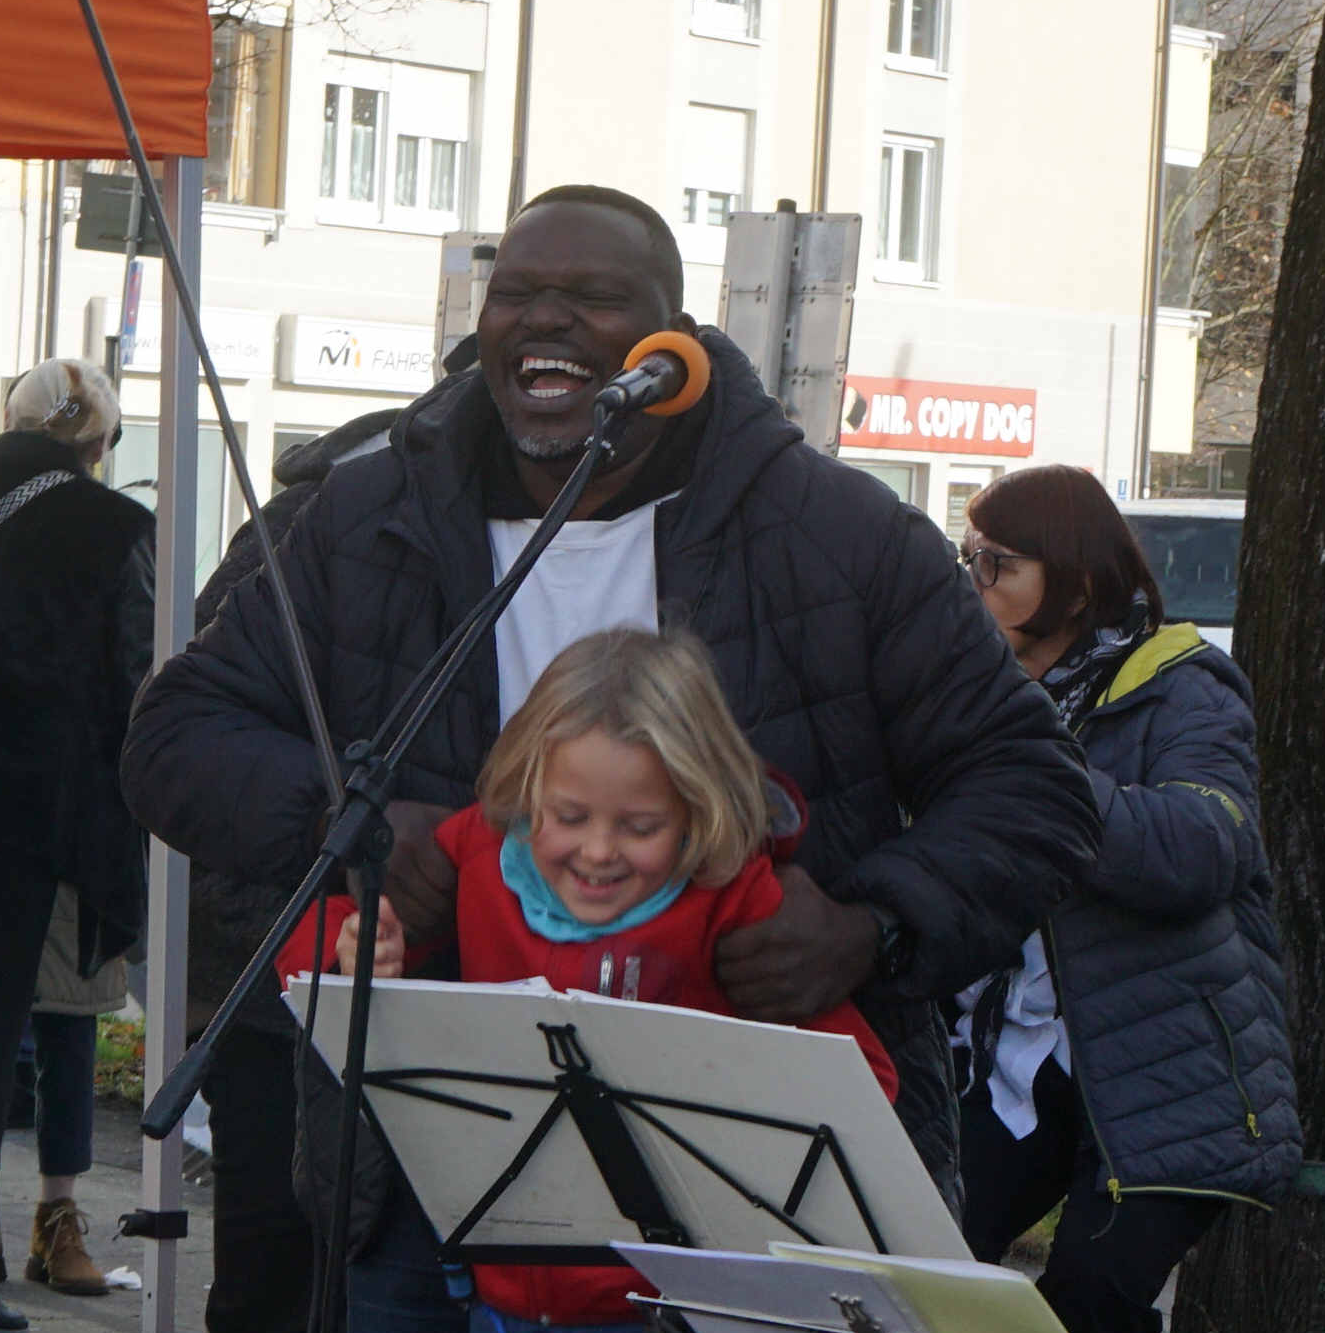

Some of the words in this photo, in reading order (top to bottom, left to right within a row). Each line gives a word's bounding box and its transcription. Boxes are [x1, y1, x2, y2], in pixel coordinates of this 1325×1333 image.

[869, 394, 914, 434] MR.
[917, 396, 980, 440] COPY
[982, 402, 1034, 444] DOG
